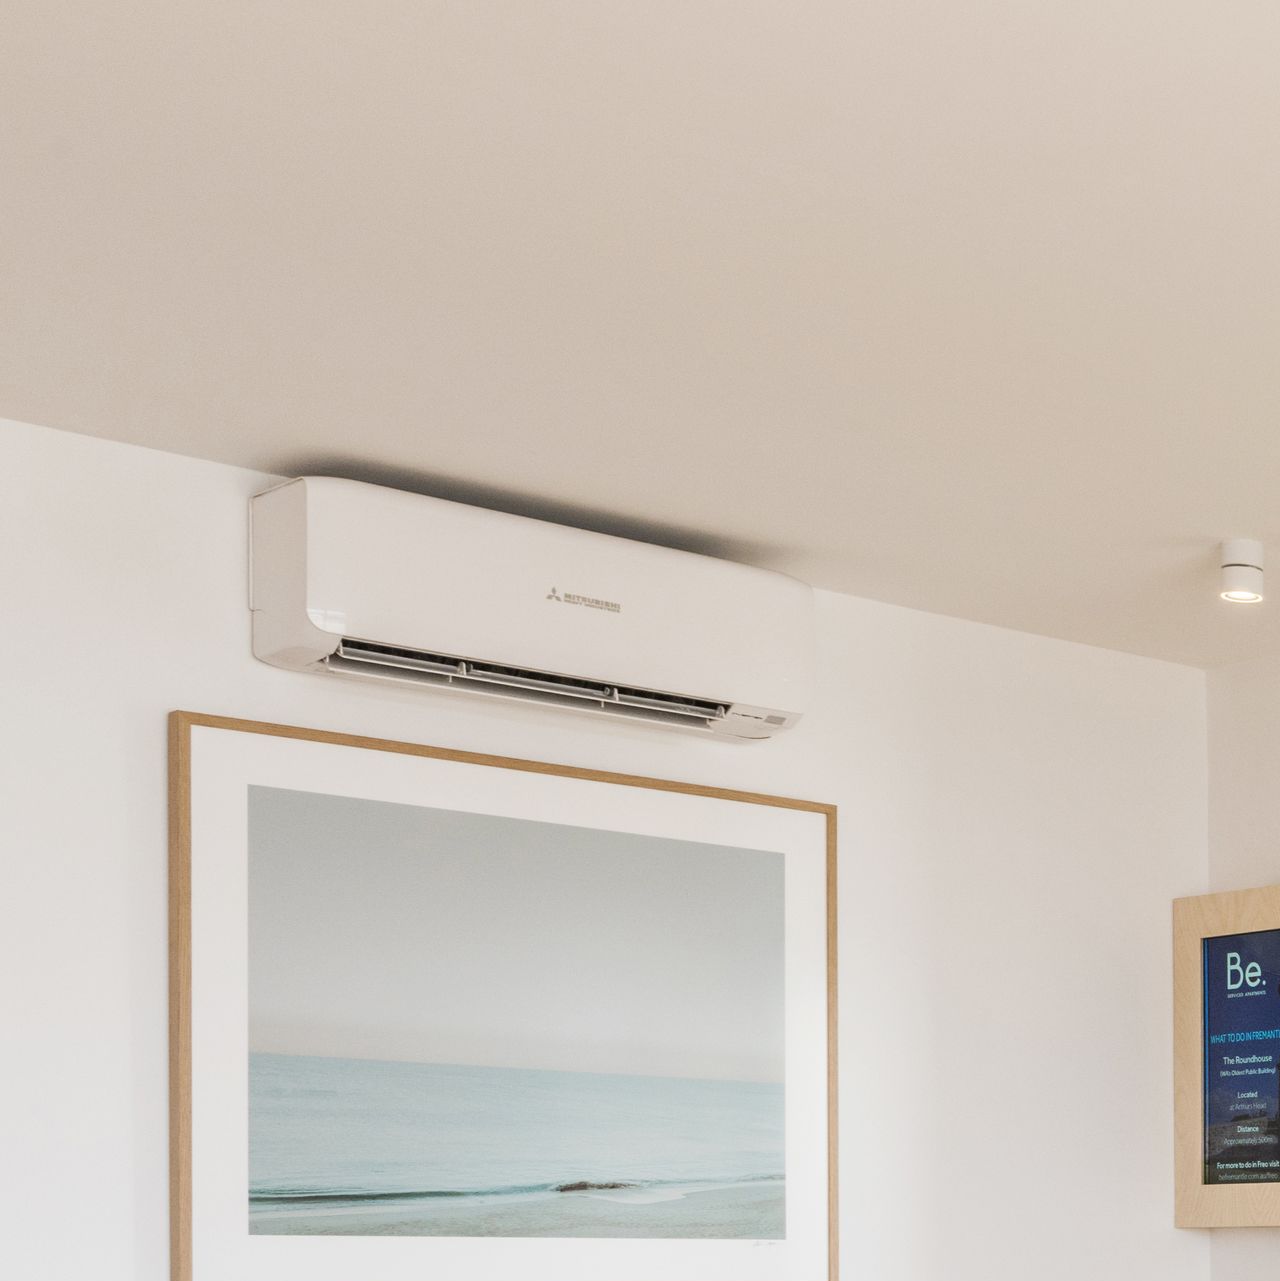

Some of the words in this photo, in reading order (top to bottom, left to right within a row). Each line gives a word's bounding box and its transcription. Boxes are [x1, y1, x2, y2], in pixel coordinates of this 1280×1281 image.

[1227, 952, 1266, 990] Be.
[1210, 1034, 1226, 1044] WHAT
[1228, 1033, 1235, 1042] TO
[1236, 1032, 1244, 1041] DO
[1245, 1032, 1252, 1040] IN
[1223, 1056, 1235, 1065] The
[1235, 1055, 1272, 1064] Roundhouse
